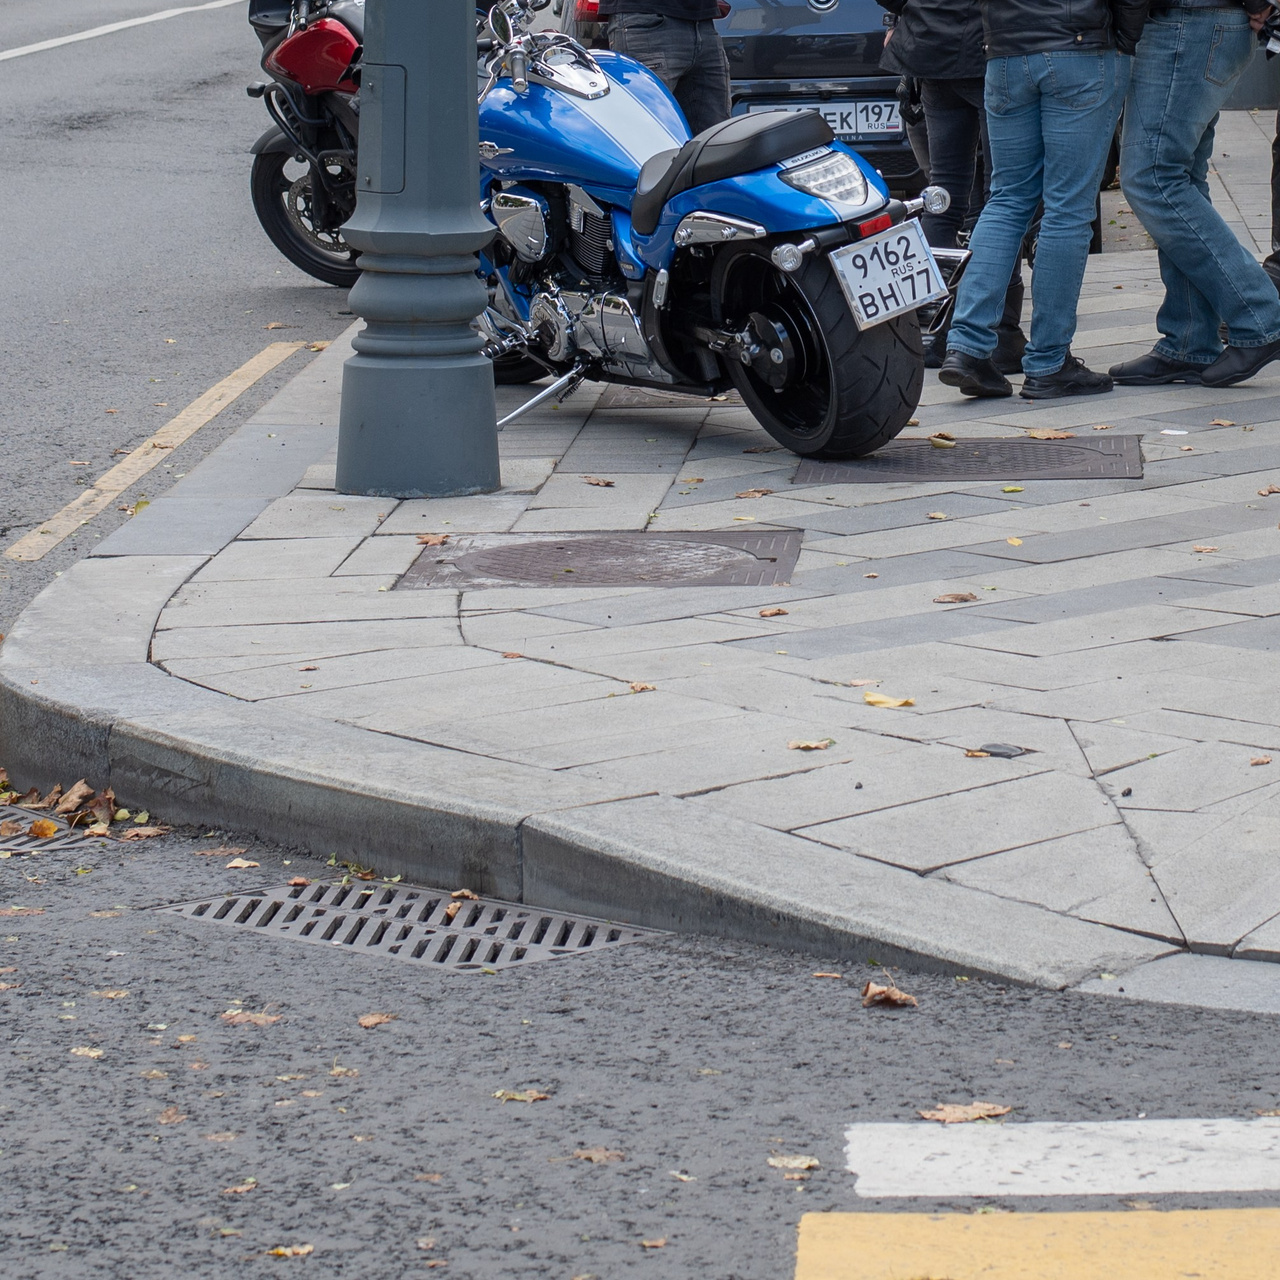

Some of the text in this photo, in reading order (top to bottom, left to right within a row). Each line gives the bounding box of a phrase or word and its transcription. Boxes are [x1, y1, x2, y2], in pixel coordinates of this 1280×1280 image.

[859, 104, 896, 123] 197
[867, 122, 885, 130] RUS
[791, 149, 824, 164] SUZUKI
[851, 235, 917, 279] 9162
[891, 262, 914, 278] RUS
